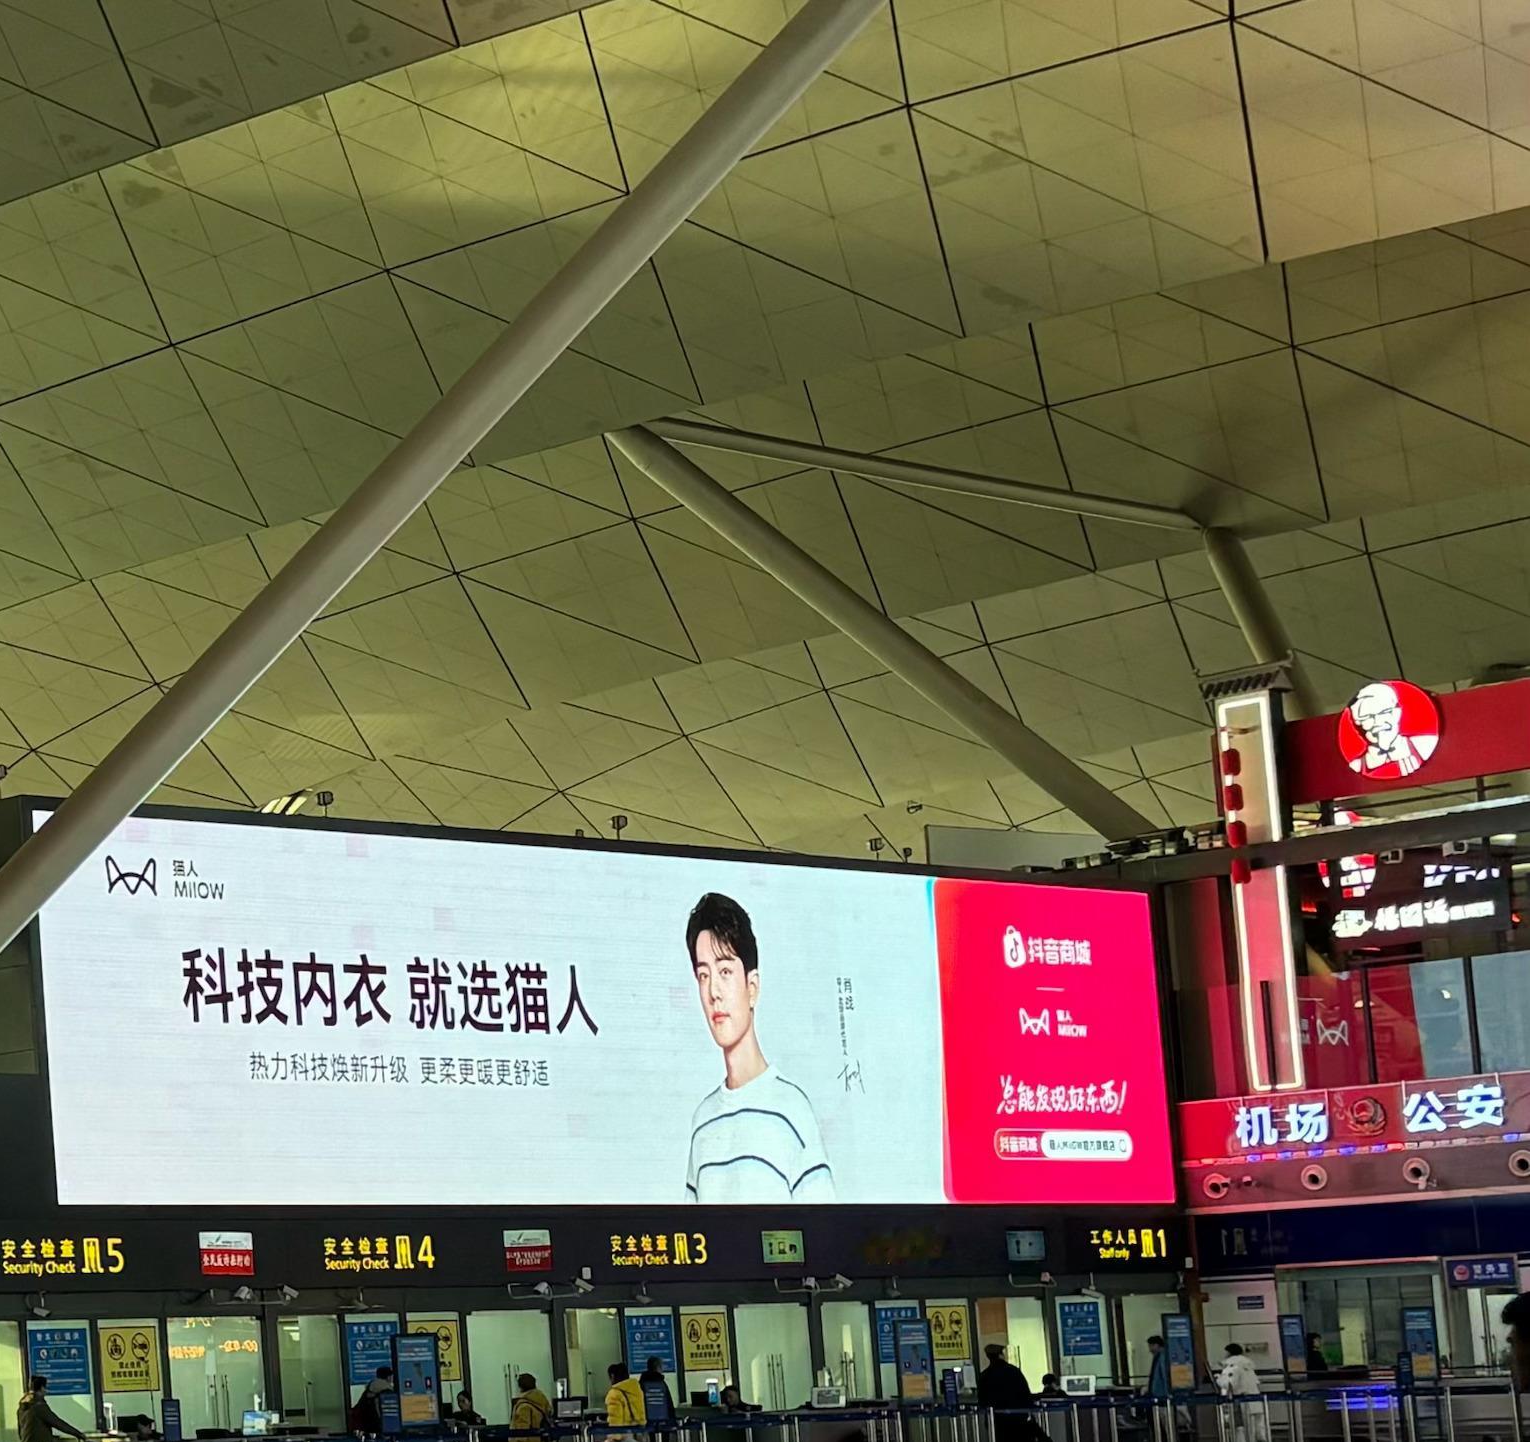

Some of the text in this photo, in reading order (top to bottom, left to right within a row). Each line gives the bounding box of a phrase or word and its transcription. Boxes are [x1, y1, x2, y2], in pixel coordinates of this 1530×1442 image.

[172, 859, 199, 878] 猫人
[173, 881, 225, 902] MIIOW
[1027, 936, 1092, 967] 抖音商城
[181, 947, 600, 1037] 科技内衣 就选猫人
[248, 1050, 551, 1088] 热力科技焕新升级 更柔更暖更舒适
[1235, 1083, 1505, 1149] 机场 公安
[1, 1237, 125, 1274] 安全检查 5
[323, 1235, 436, 1270] 安全检查 4
[610, 1232, 708, 1265] 安全检查 3
[1156, 1228, 1167, 1258] 1
[2, 1259, 76, 1277] Security Check
[324, 1256, 390, 1273] Security Check
[611, 1253, 669, 1268] Security Check
